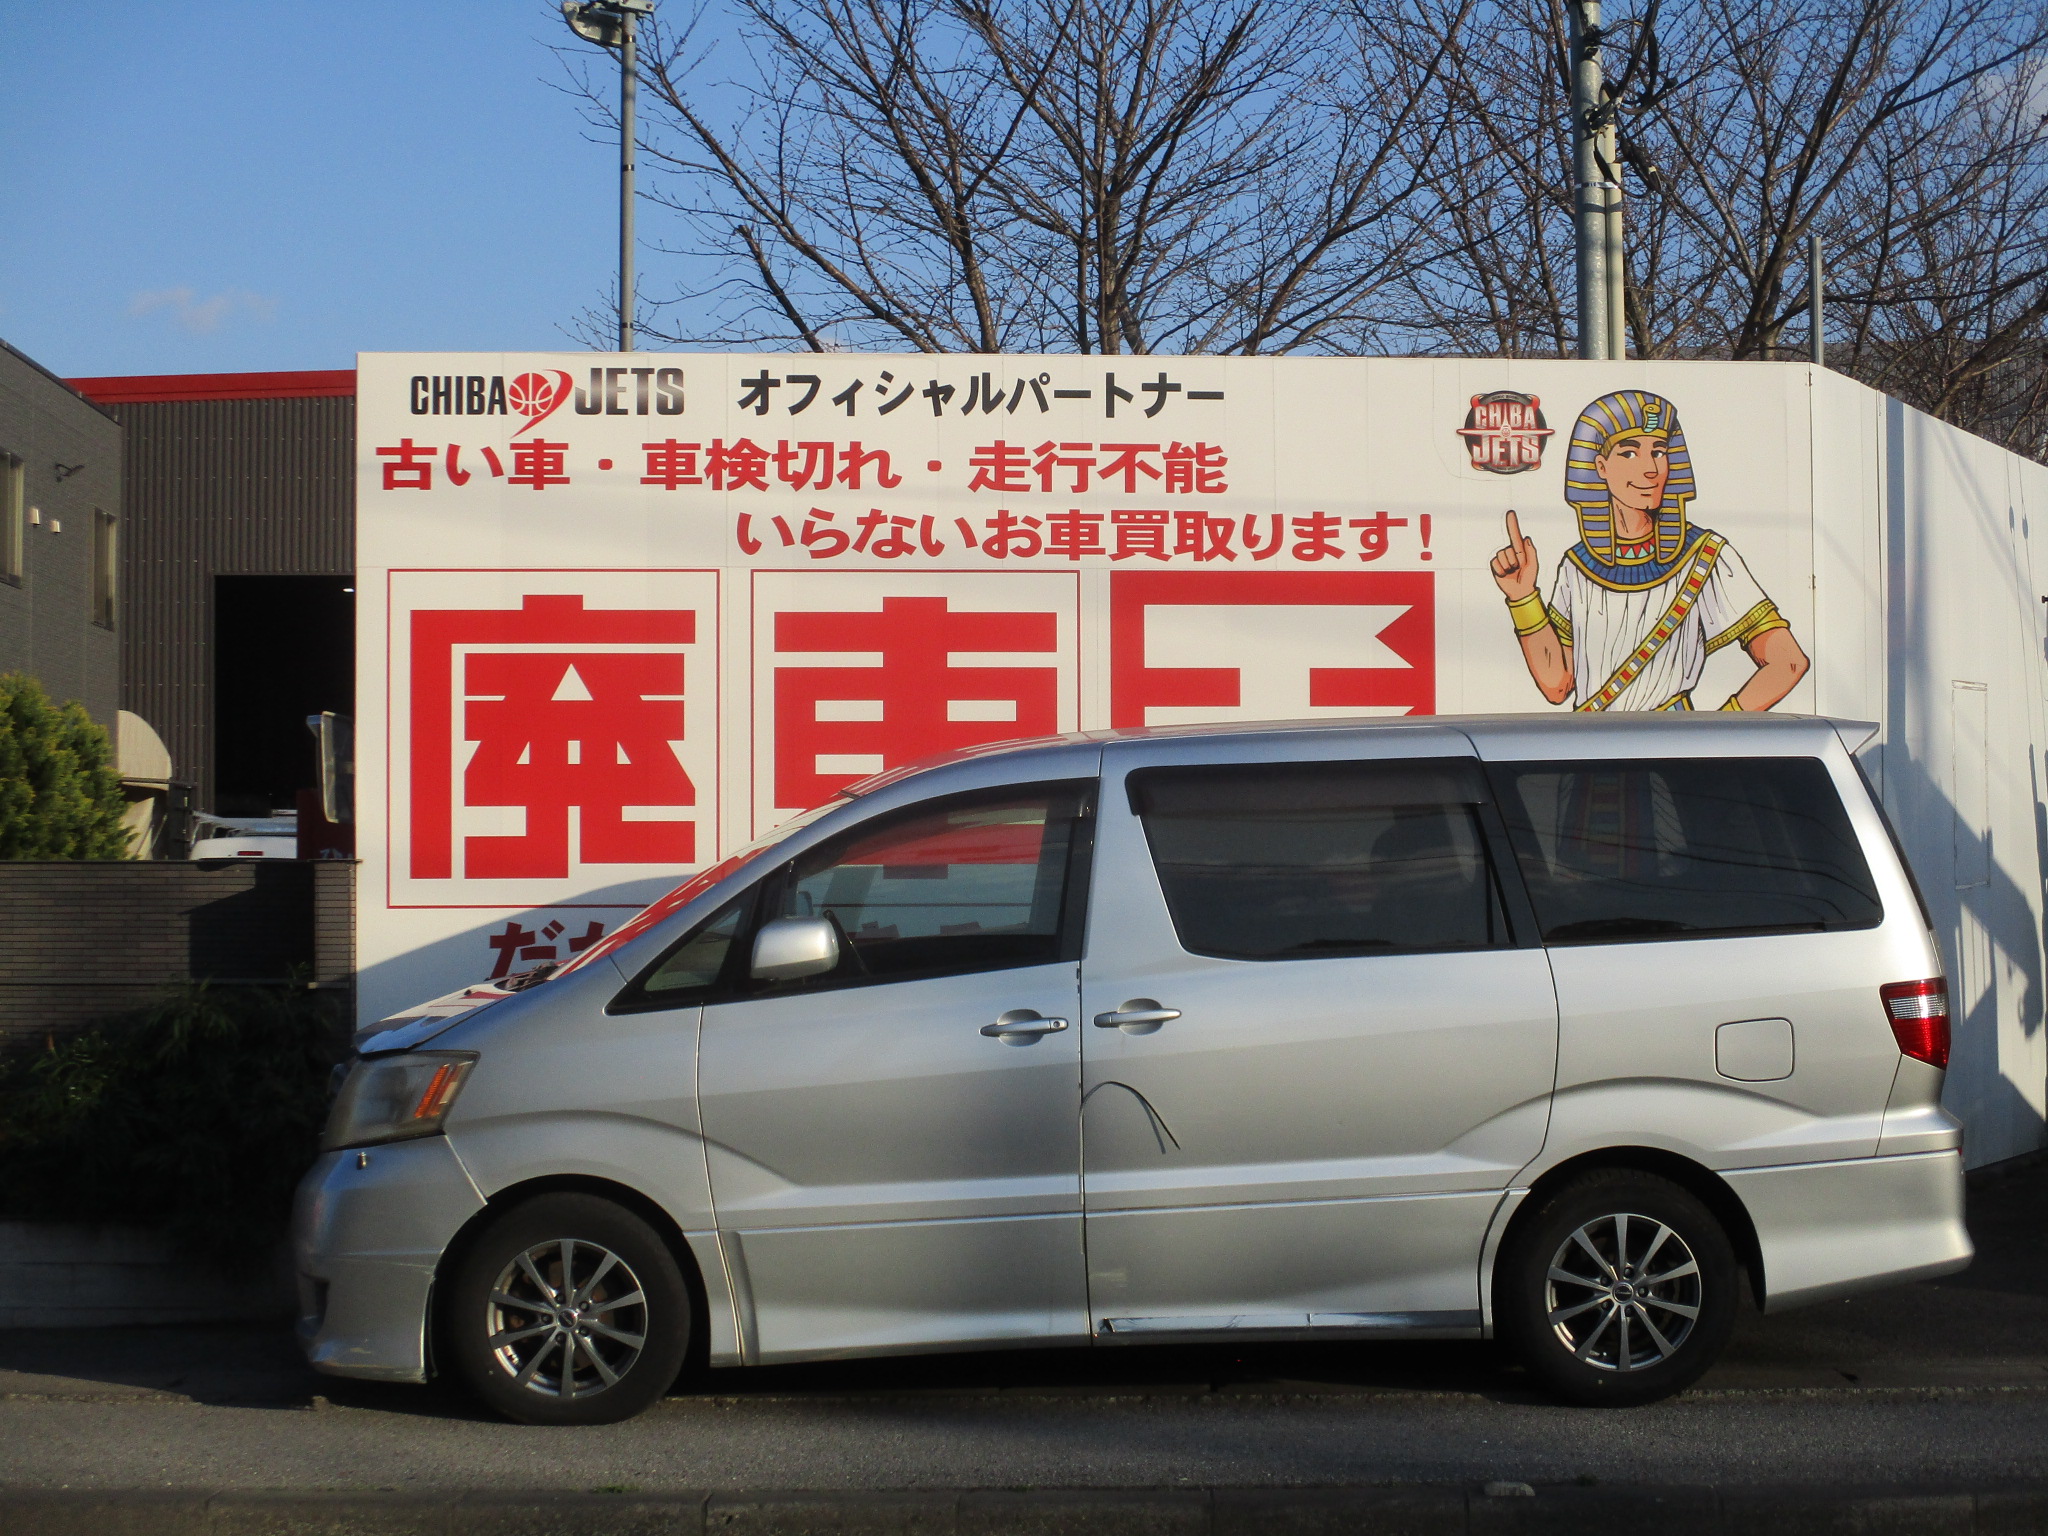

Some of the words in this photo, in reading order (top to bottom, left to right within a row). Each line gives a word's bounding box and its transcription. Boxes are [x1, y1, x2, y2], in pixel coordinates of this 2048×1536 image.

[410, 375, 508, 416] CHIBA
[574, 367, 685, 416] JETS
[737, 369, 1225, 418] オフィシャルパートナー
[1472, 434, 1540, 466] JETS
[736, 506, 1433, 563] いらないお車買取ります!
